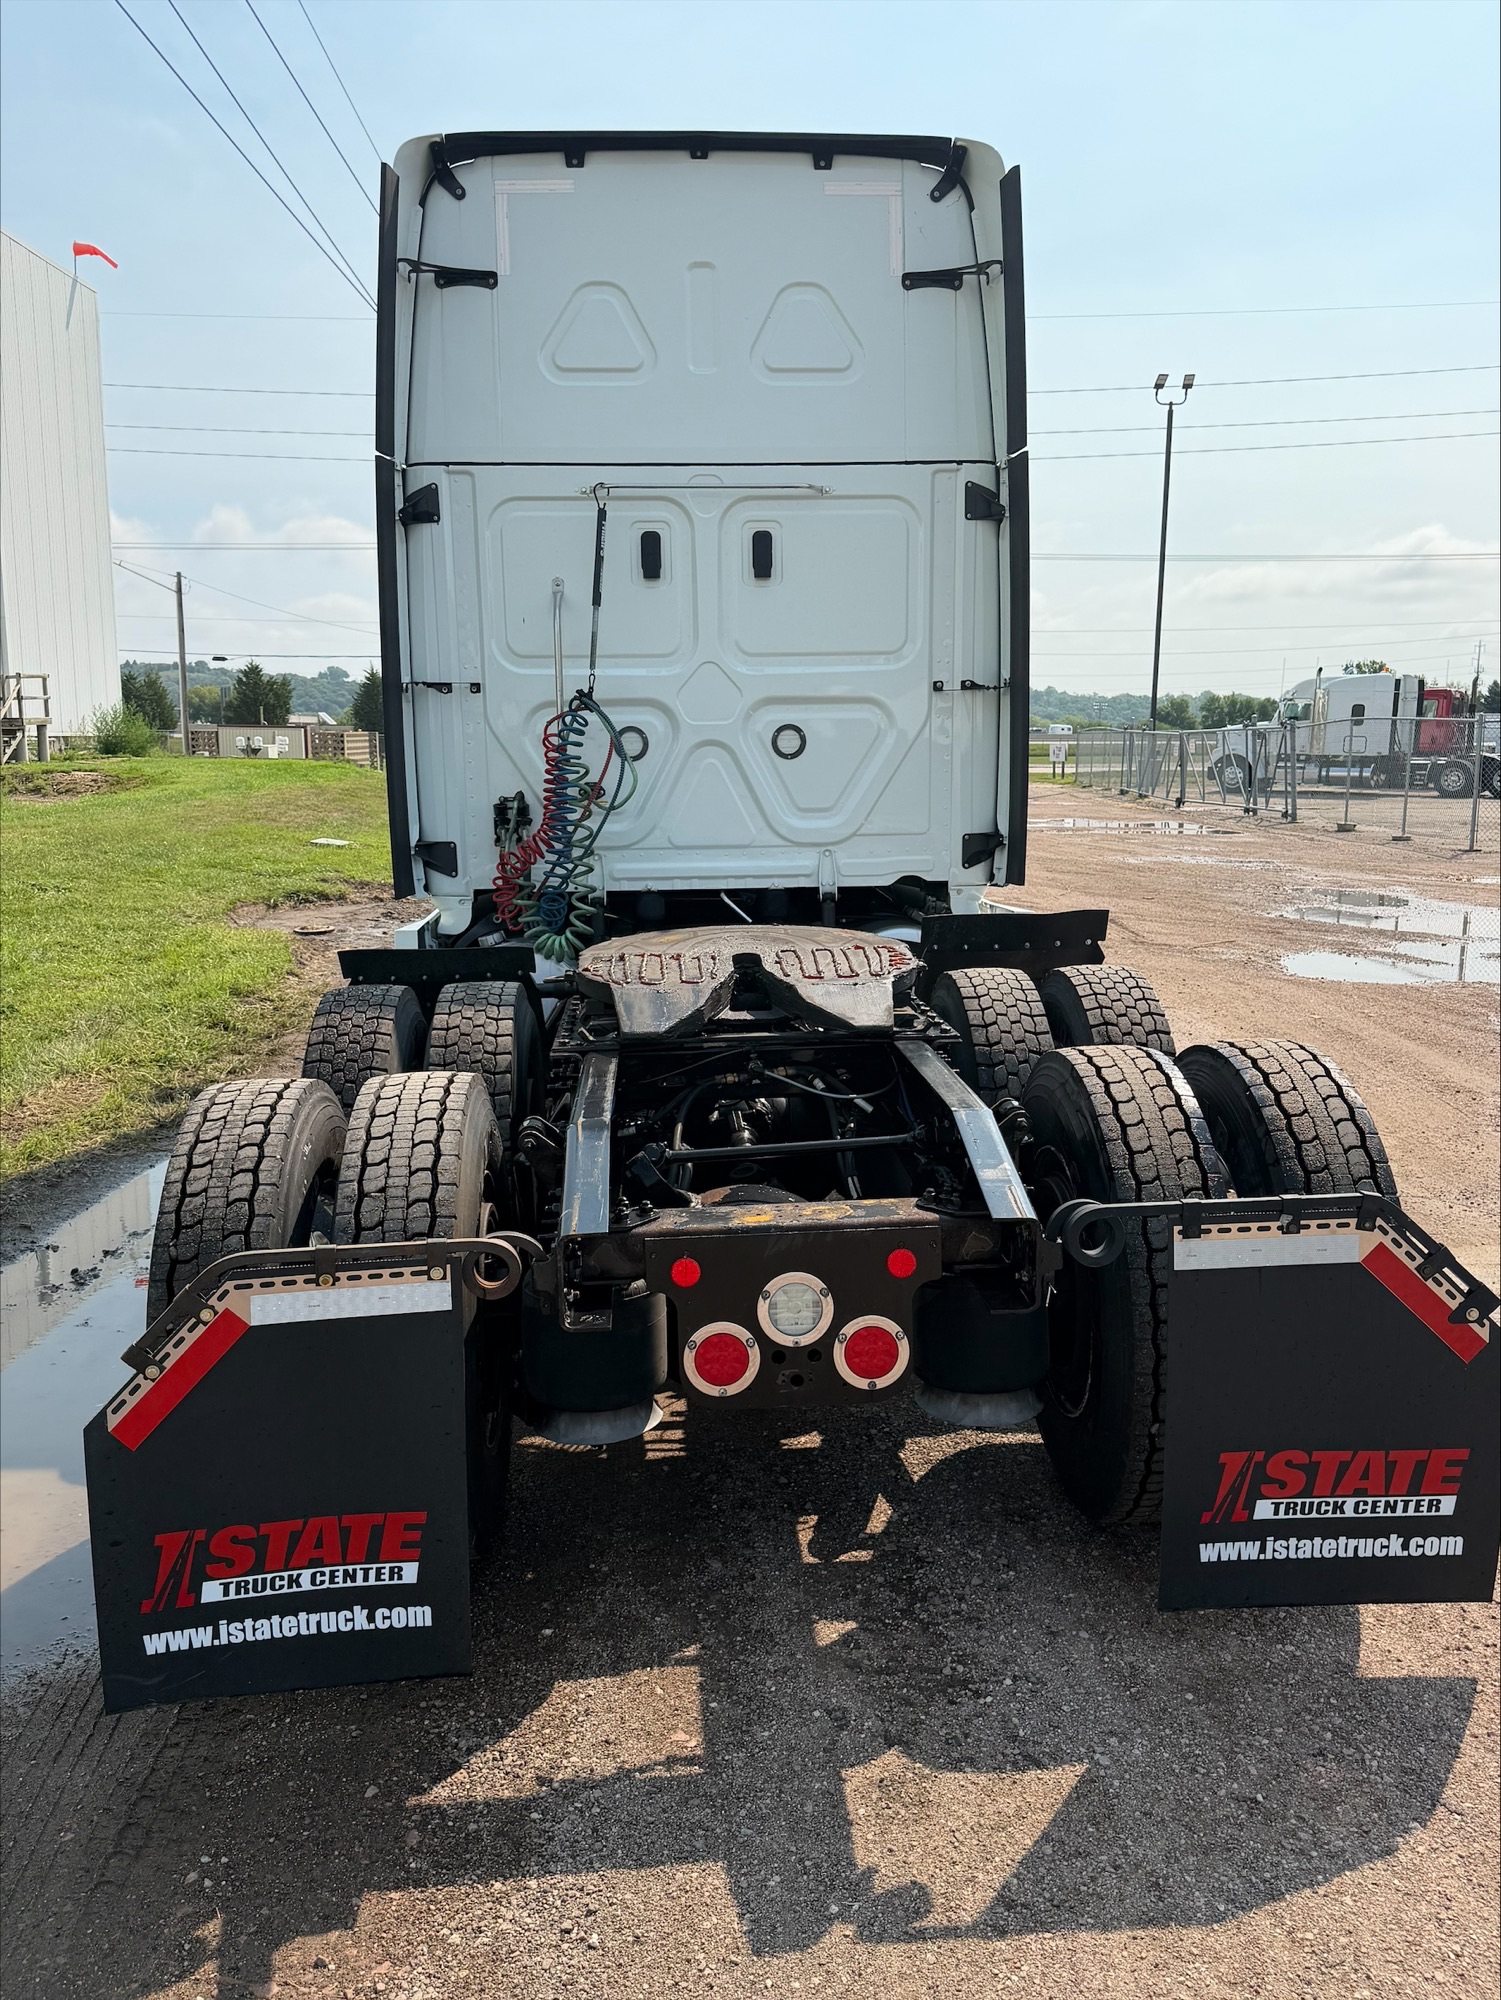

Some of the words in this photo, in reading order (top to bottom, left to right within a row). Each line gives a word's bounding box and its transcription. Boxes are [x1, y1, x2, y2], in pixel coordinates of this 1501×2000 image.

[1270, 1500, 1348, 1517] TRUCK
[1353, 1498, 1442, 1515] CENTER
[1199, 1533, 1464, 1562] www.istatetruck.com
[218, 1572, 304, 1598] TRUCK
[310, 1565, 404, 1588] CENTER
[143, 1605, 432, 1655] www.istatetruck.com
